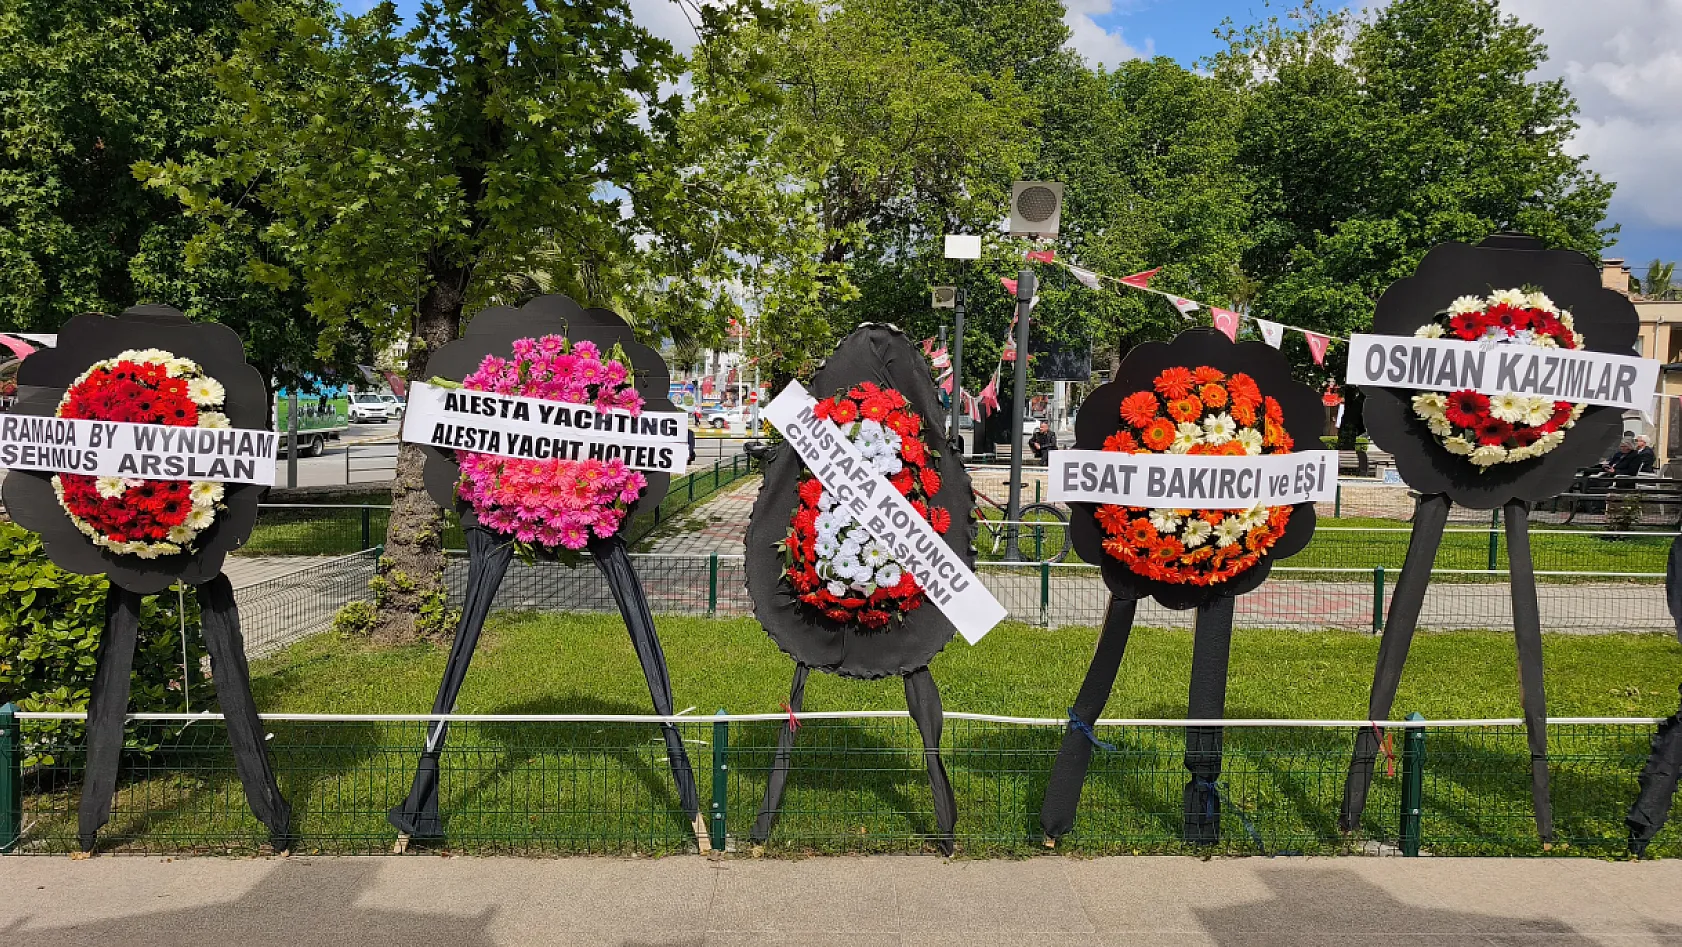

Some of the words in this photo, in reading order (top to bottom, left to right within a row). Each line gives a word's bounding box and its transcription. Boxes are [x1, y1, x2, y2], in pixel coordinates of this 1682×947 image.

[1365, 343, 1486, 389] OSMAN
[1496, 352, 1638, 403] KAZIMLAR
[2, 416, 76, 447] RAMADA
[89, 423, 118, 449] BY
[133, 426, 275, 459] WYNDHAM
[444, 392, 530, 422] ALESTA
[538, 404, 678, 437] YACHTING
[117, 453, 255, 479] ARSLAN
[431, 422, 500, 453] ALESTA
[506, 432, 583, 462] YACHT
[589, 442, 674, 469] HOTELS
[785, 423, 820, 461] CHP
[818, 462, 868, 516] İLÇE
[1062, 461, 1138, 495] ESAT
[1147, 466, 1262, 499] BAKIRCI
[1268, 472, 1290, 498] ve
[1293, 455, 1327, 500] EŞİ
[796, 405, 878, 500] MUSTAFA
[876, 495, 970, 593] KOYUNCU
